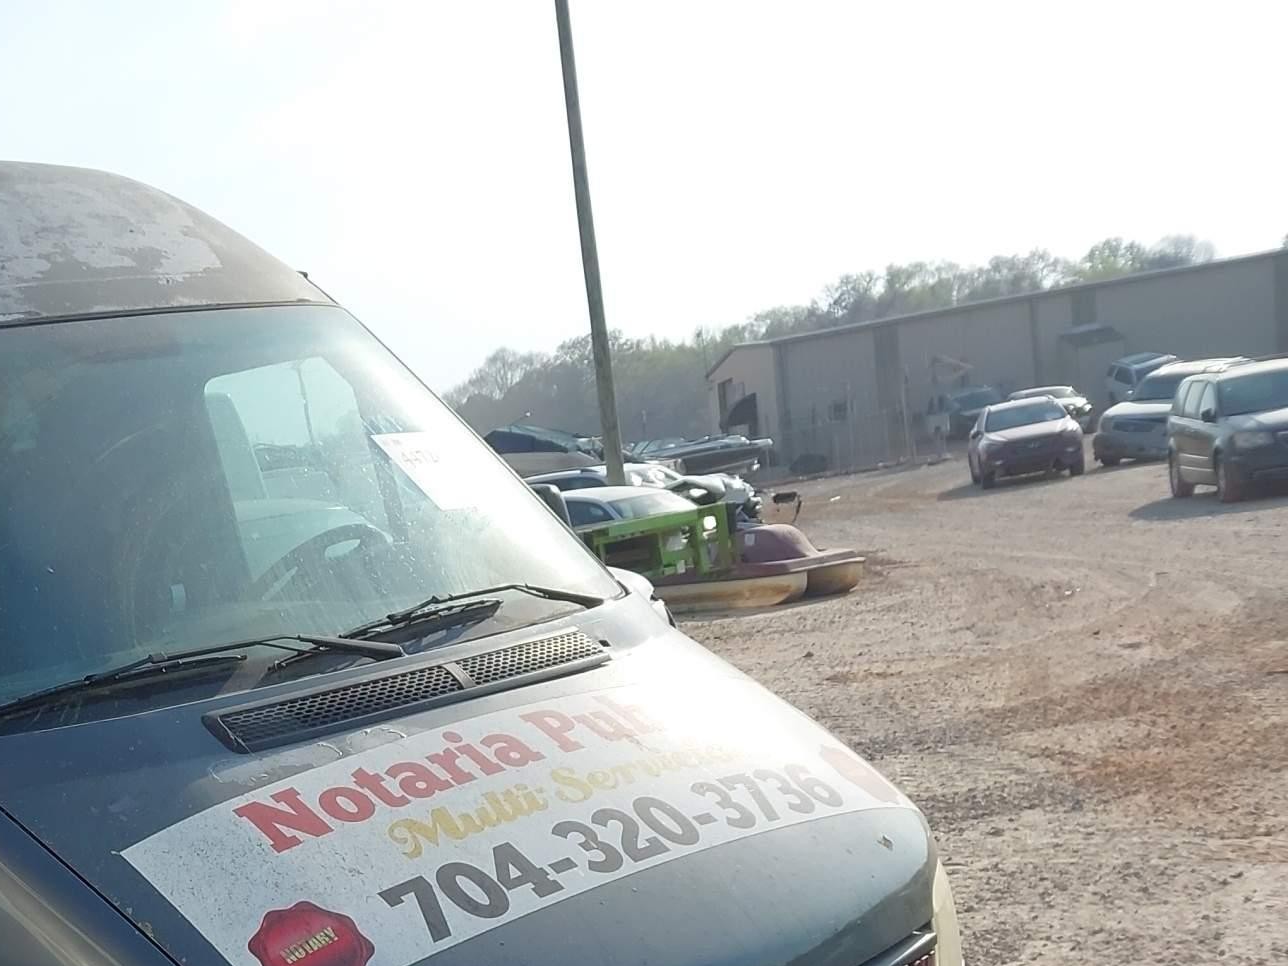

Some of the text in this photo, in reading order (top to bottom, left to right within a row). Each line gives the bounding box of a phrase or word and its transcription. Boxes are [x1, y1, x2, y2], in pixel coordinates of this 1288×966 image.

[232, 731, 545, 854] Notaria
[388, 784, 548, 861] Multi
[377, 763, 843, 943] 704-320-3736
[280, 927, 338, 965] NOTARY
